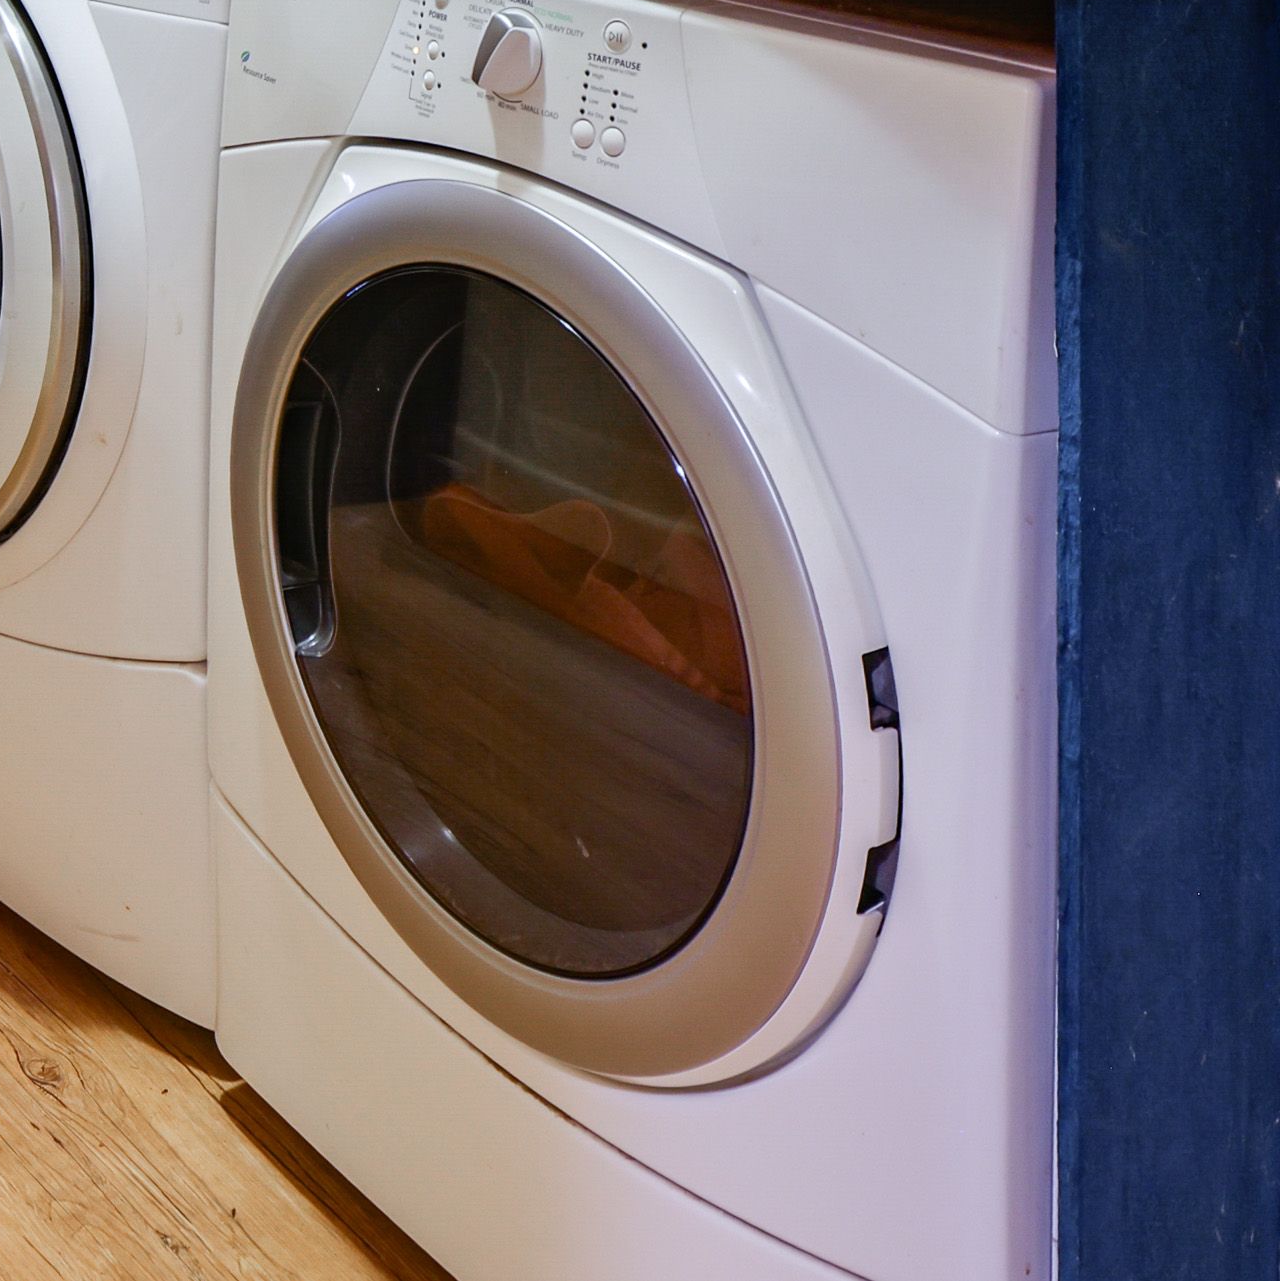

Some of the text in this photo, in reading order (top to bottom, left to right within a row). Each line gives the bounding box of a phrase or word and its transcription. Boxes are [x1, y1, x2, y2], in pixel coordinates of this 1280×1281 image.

[428, 9, 448, 22] POWER
[544, 23, 585, 39] HEAVY DUTY
[587, 52, 641, 72] START/PAUSE
[242, 65, 277, 84] Resource Saver
[520, 102, 559, 120] SMALL LOAD
